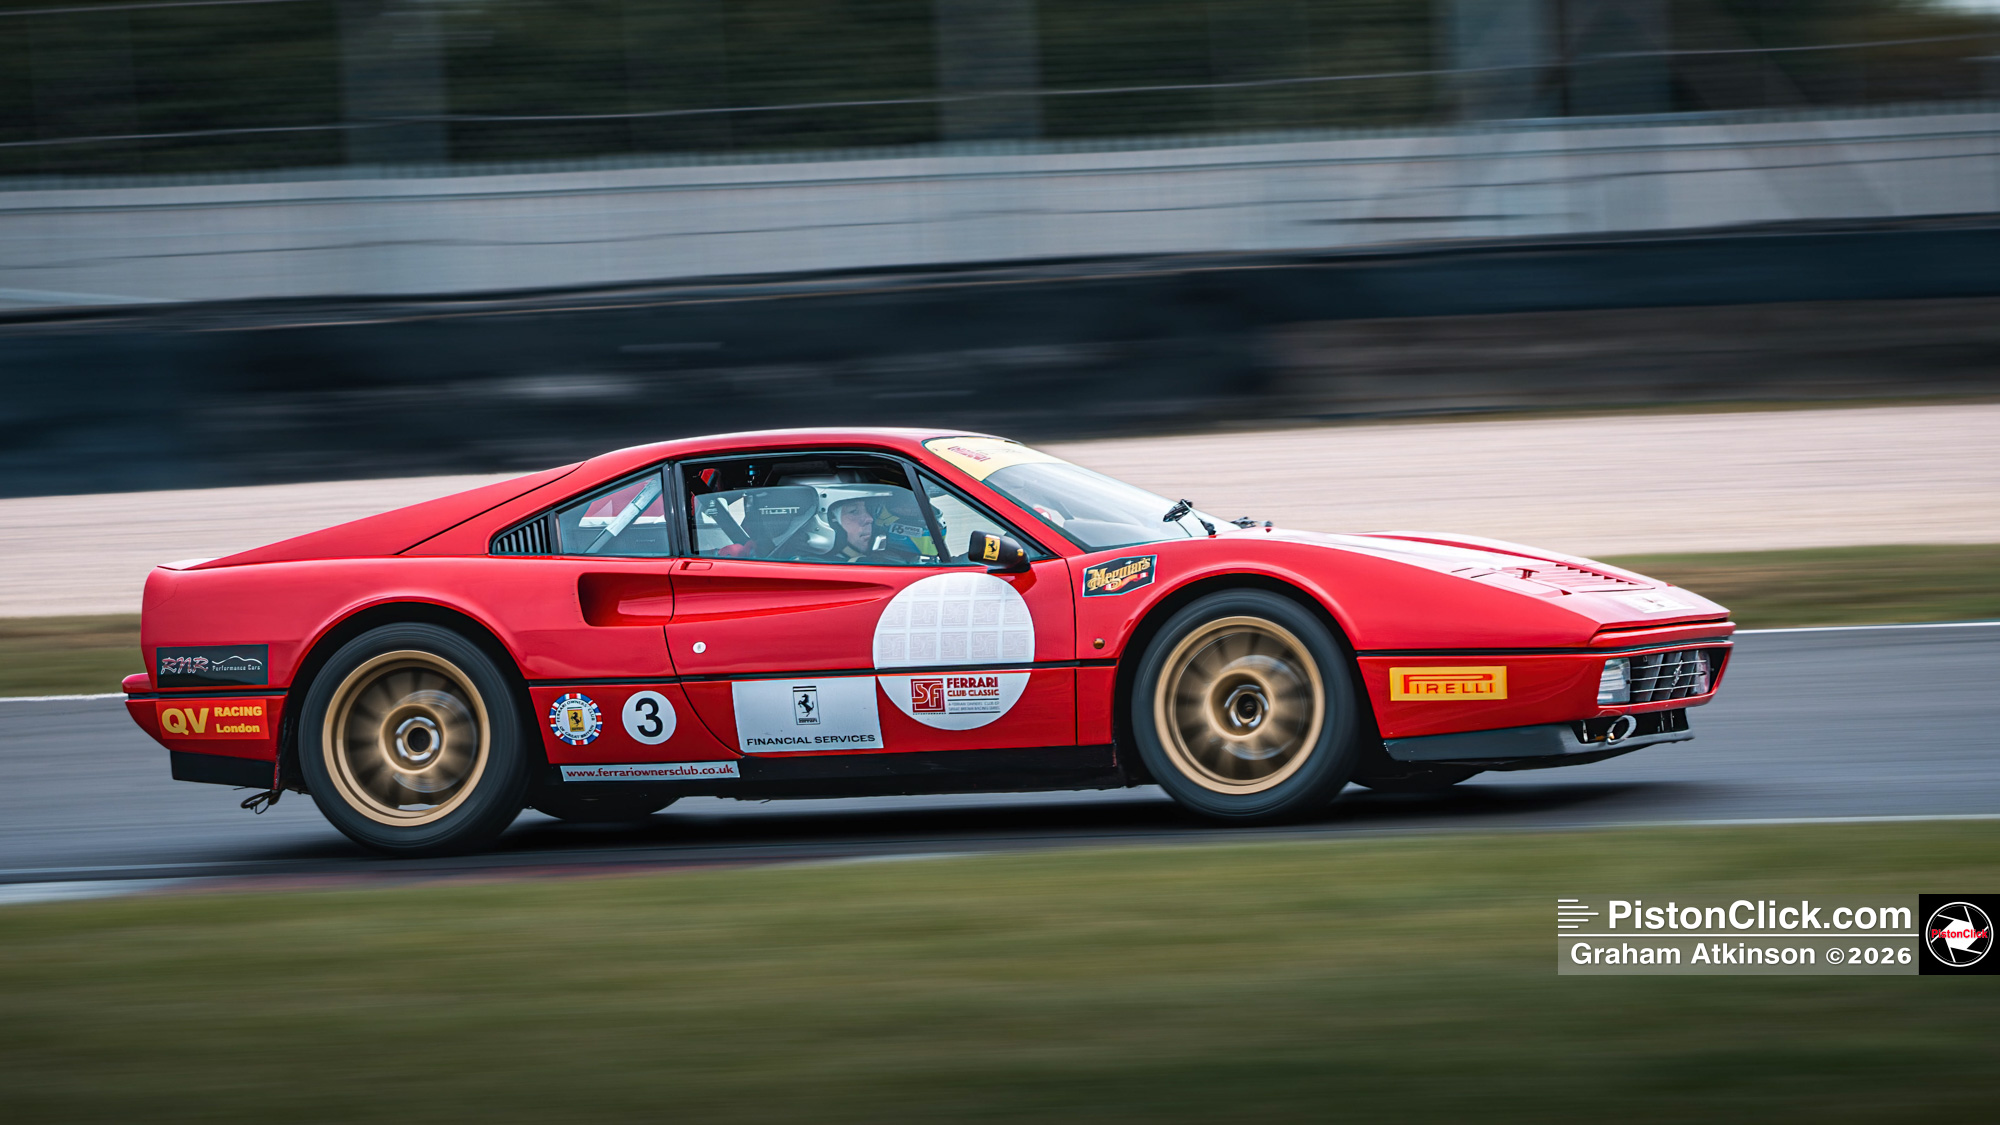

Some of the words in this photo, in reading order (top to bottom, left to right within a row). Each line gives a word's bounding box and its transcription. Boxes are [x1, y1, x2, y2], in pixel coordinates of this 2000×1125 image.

[1086, 557, 1151, 591] Meguiar's
[946, 677, 999, 688] FERRARI
[1403, 674, 1494, 694] PIRELLI
[968, 689, 1000, 697] CLASSIC
[161, 708, 209, 735] QV
[214, 706, 262, 717] RACING
[635, 697, 663, 738] 3
[216, 723, 260, 733] London
[746, 735, 812, 747] FINANCIAL
[814, 733, 876, 744] SERVICES
[566, 765, 734, 778] www.ferrariownersclub.co.uk
